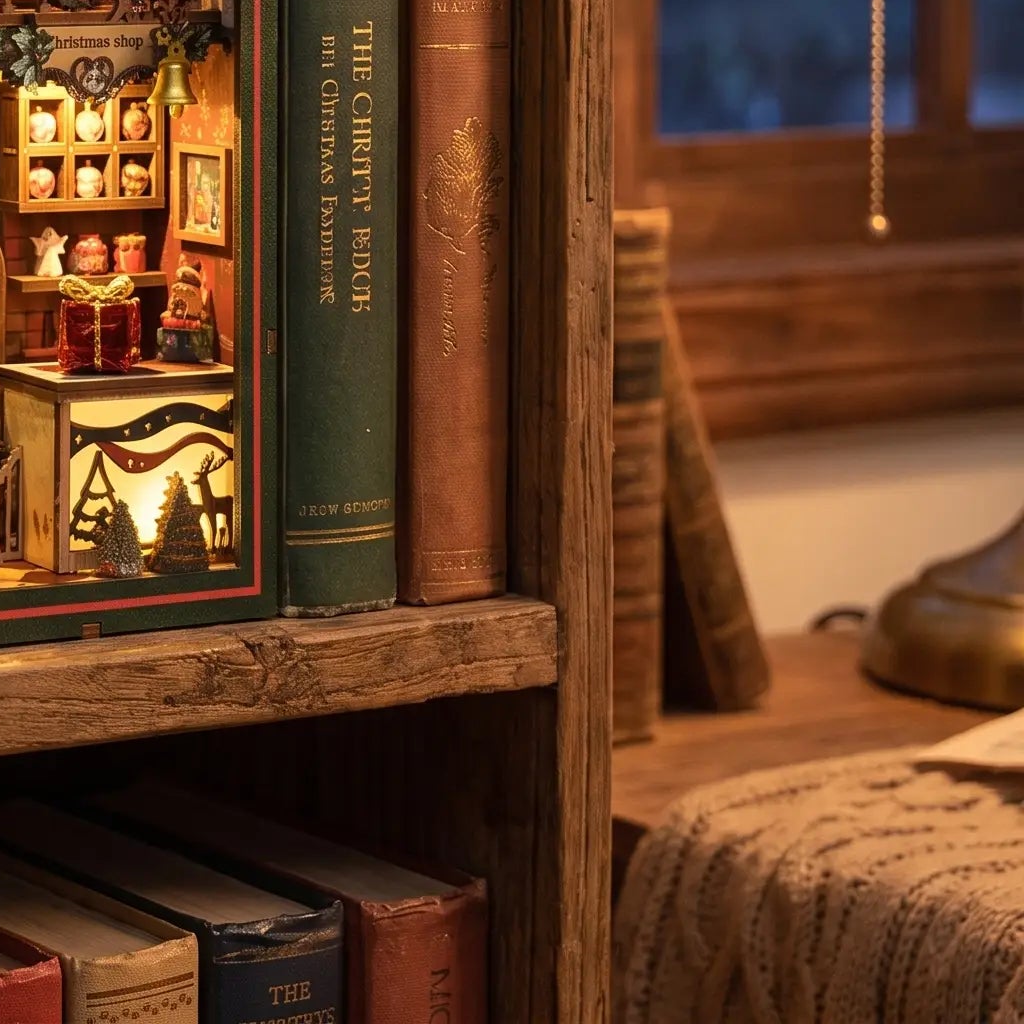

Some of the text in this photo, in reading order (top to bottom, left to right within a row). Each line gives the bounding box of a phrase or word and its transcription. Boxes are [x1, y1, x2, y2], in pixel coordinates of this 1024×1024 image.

[55, 34, 144, 51] hristmas shop
[352, 21, 373, 82] THE
[269, 981, 312, 1006] THE
